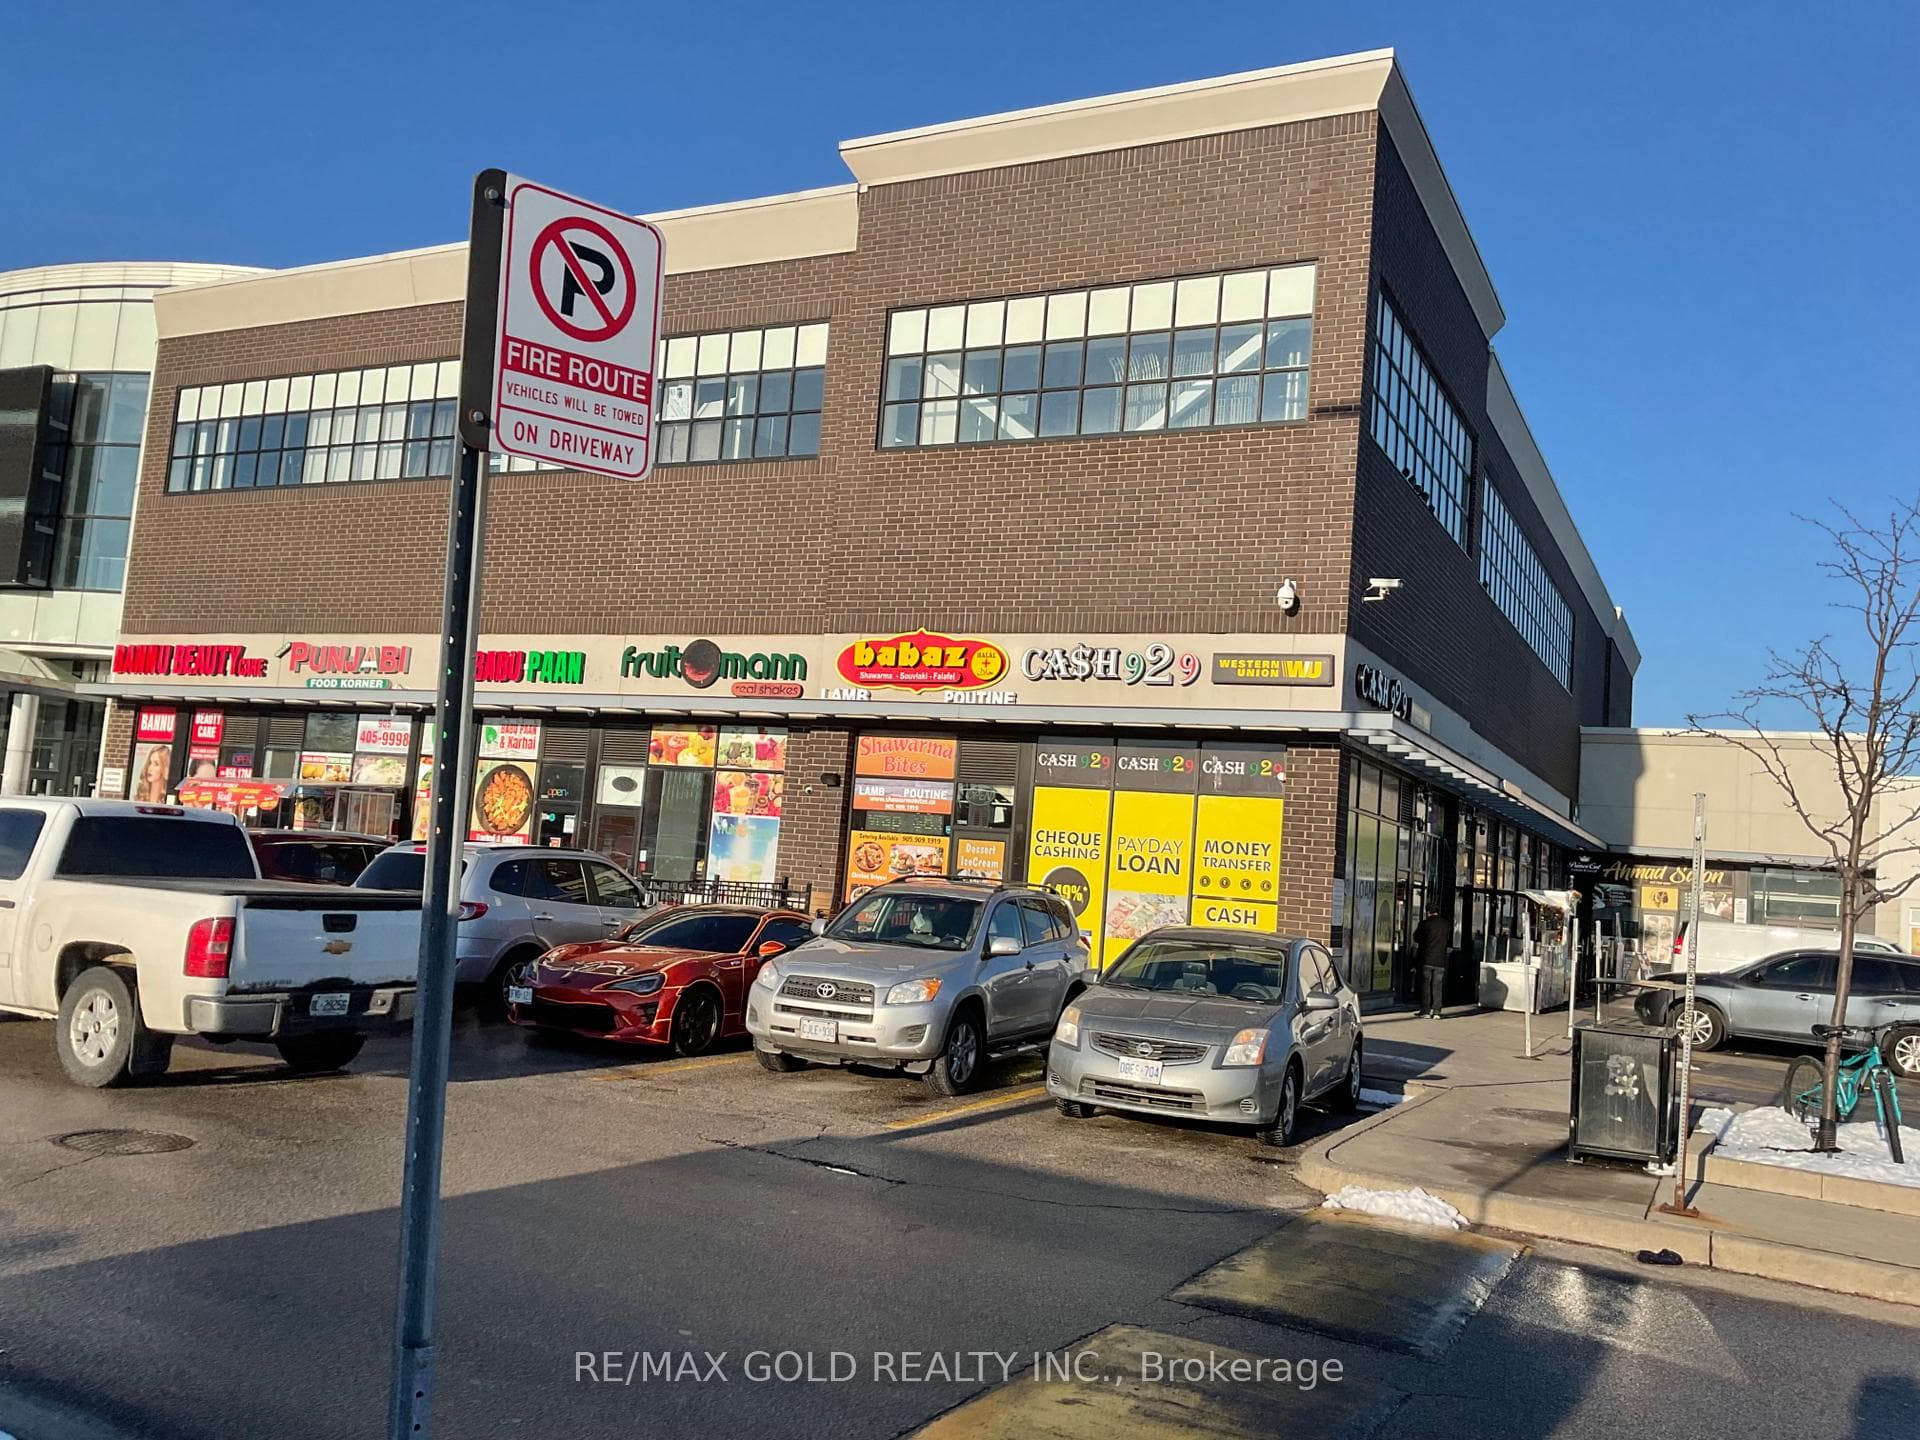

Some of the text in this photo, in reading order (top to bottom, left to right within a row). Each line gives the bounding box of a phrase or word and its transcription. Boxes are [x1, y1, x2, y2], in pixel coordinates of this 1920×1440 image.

[506, 341, 648, 399] FIRE ROUTE
[506, 381, 645, 426] VEHICLES WILL BE TOWED
[514, 420, 634, 465] ON DRIVEWAY
[112, 645, 174, 675] BANNU
[173, 645, 246, 676] BEAUTY
[289, 642, 410, 674] PUNJABI
[853, 641, 967, 668] babaz
[474, 651, 586, 684] BABU PAAN
[1123, 643, 1201, 686] 929
[1219, 659, 1323, 678] WESTERN WU
[1237, 668, 1279, 677] UNION
[310, 679, 384, 689] FOOD KORNER
[859, 671, 956, 681] Shawarma Souvlaki Falafel
[735, 683, 799, 695] real shakes
[820, 687, 1016, 704] LAMB POUTINE
[1391, 680, 1408, 719] 929
[141, 713, 176, 732] BANNU
[195, 713, 222, 725] BEAUTY
[378, 719, 392, 728] 905
[197, 725, 216, 738] CARE
[360, 730, 410, 747] 405-9998
[500, 724, 537, 735] BABU PAAN
[499, 736, 536, 749] & Karhai
[859, 736, 953, 759] Shawarma
[883, 756, 928, 774] Bites
[1038, 752, 1111, 771] CASH 929
[1118, 755, 1194, 774] CASH 929
[1202, 759, 1283, 777] CASH 929
[547, 788, 567, 797] open
[859, 786, 948, 800] LAMB POUTINE
[1035, 830, 1101, 846] CHEQUE
[1117, 836, 1184, 855] PAYDAY
[966, 842, 996, 854] Dessert
[1034, 845, 1100, 860] CASHING
[1204, 840, 1272, 857] MONEY
[960, 855, 999, 868] IceCream
[1117, 854, 1180, 875] LOAN
[1202, 856, 1271, 872] TRANSFER
[1602, 861, 1725, 884] Ahmad Saon
[1206, 907, 1257, 925] CASH
